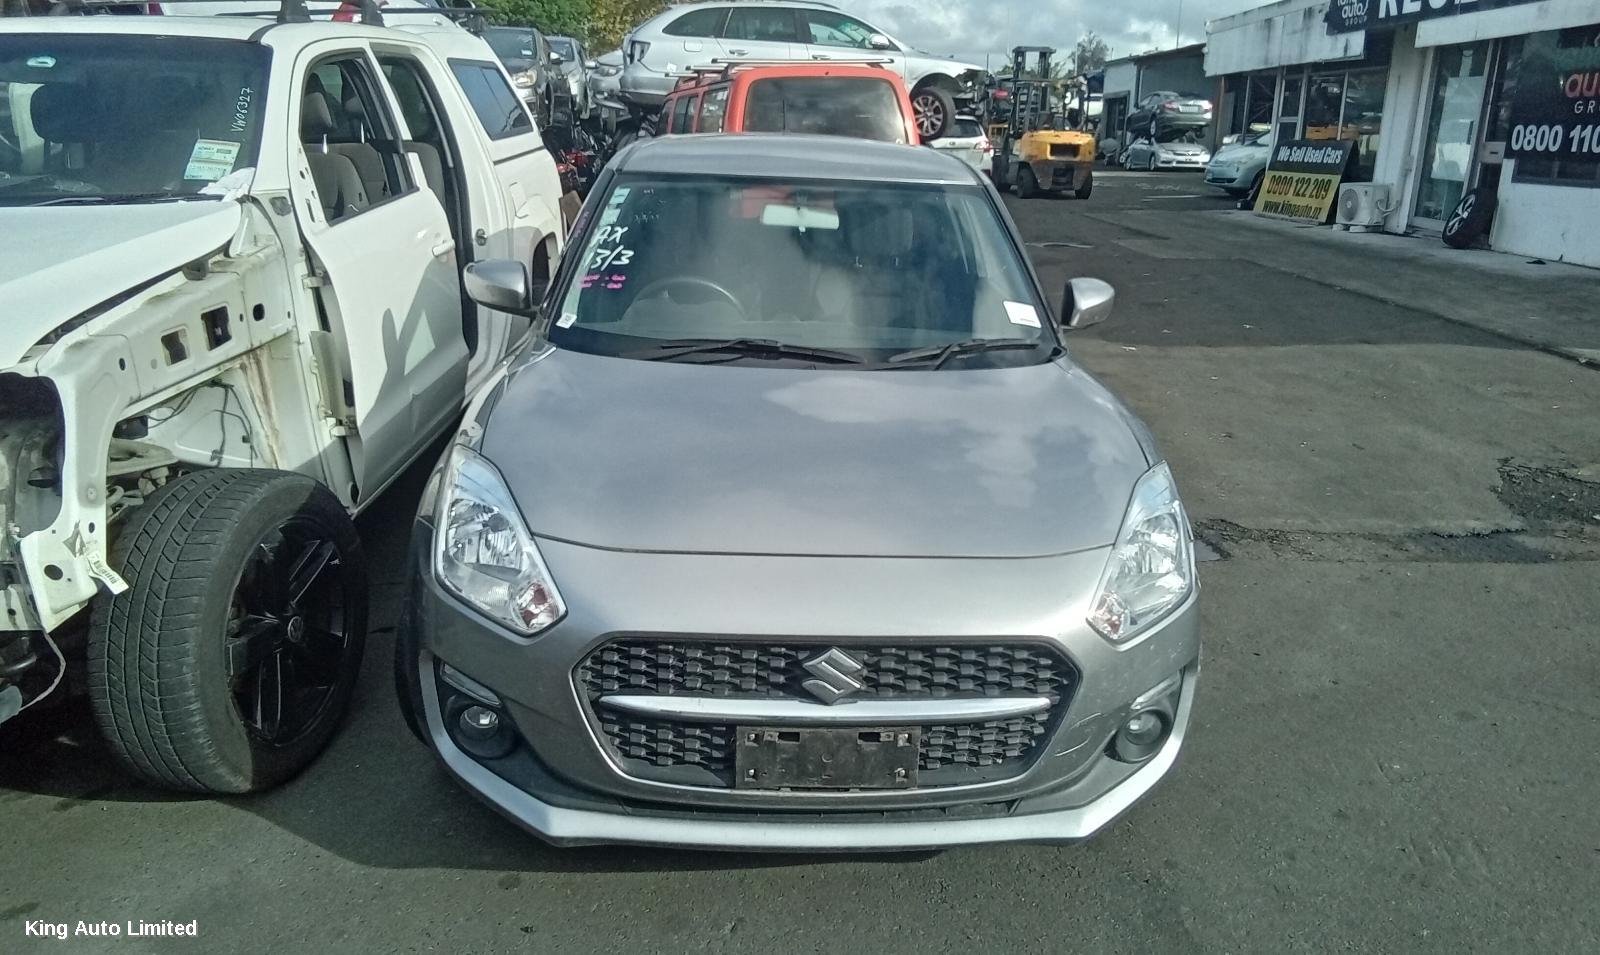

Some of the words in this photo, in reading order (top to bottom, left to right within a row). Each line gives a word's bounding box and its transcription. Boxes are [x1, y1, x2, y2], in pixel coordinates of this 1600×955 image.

[1511, 124, 1563, 152] 0800
[1277, 146, 1291, 161] We
[1289, 146, 1307, 162] Sell
[1304, 146, 1326, 163] Used
[1323, 147, 1343, 164] Cars
[1267, 175, 1294, 196] 0800
[1292, 177, 1312, 197] 122
[1309, 178, 1333, 200] 209
